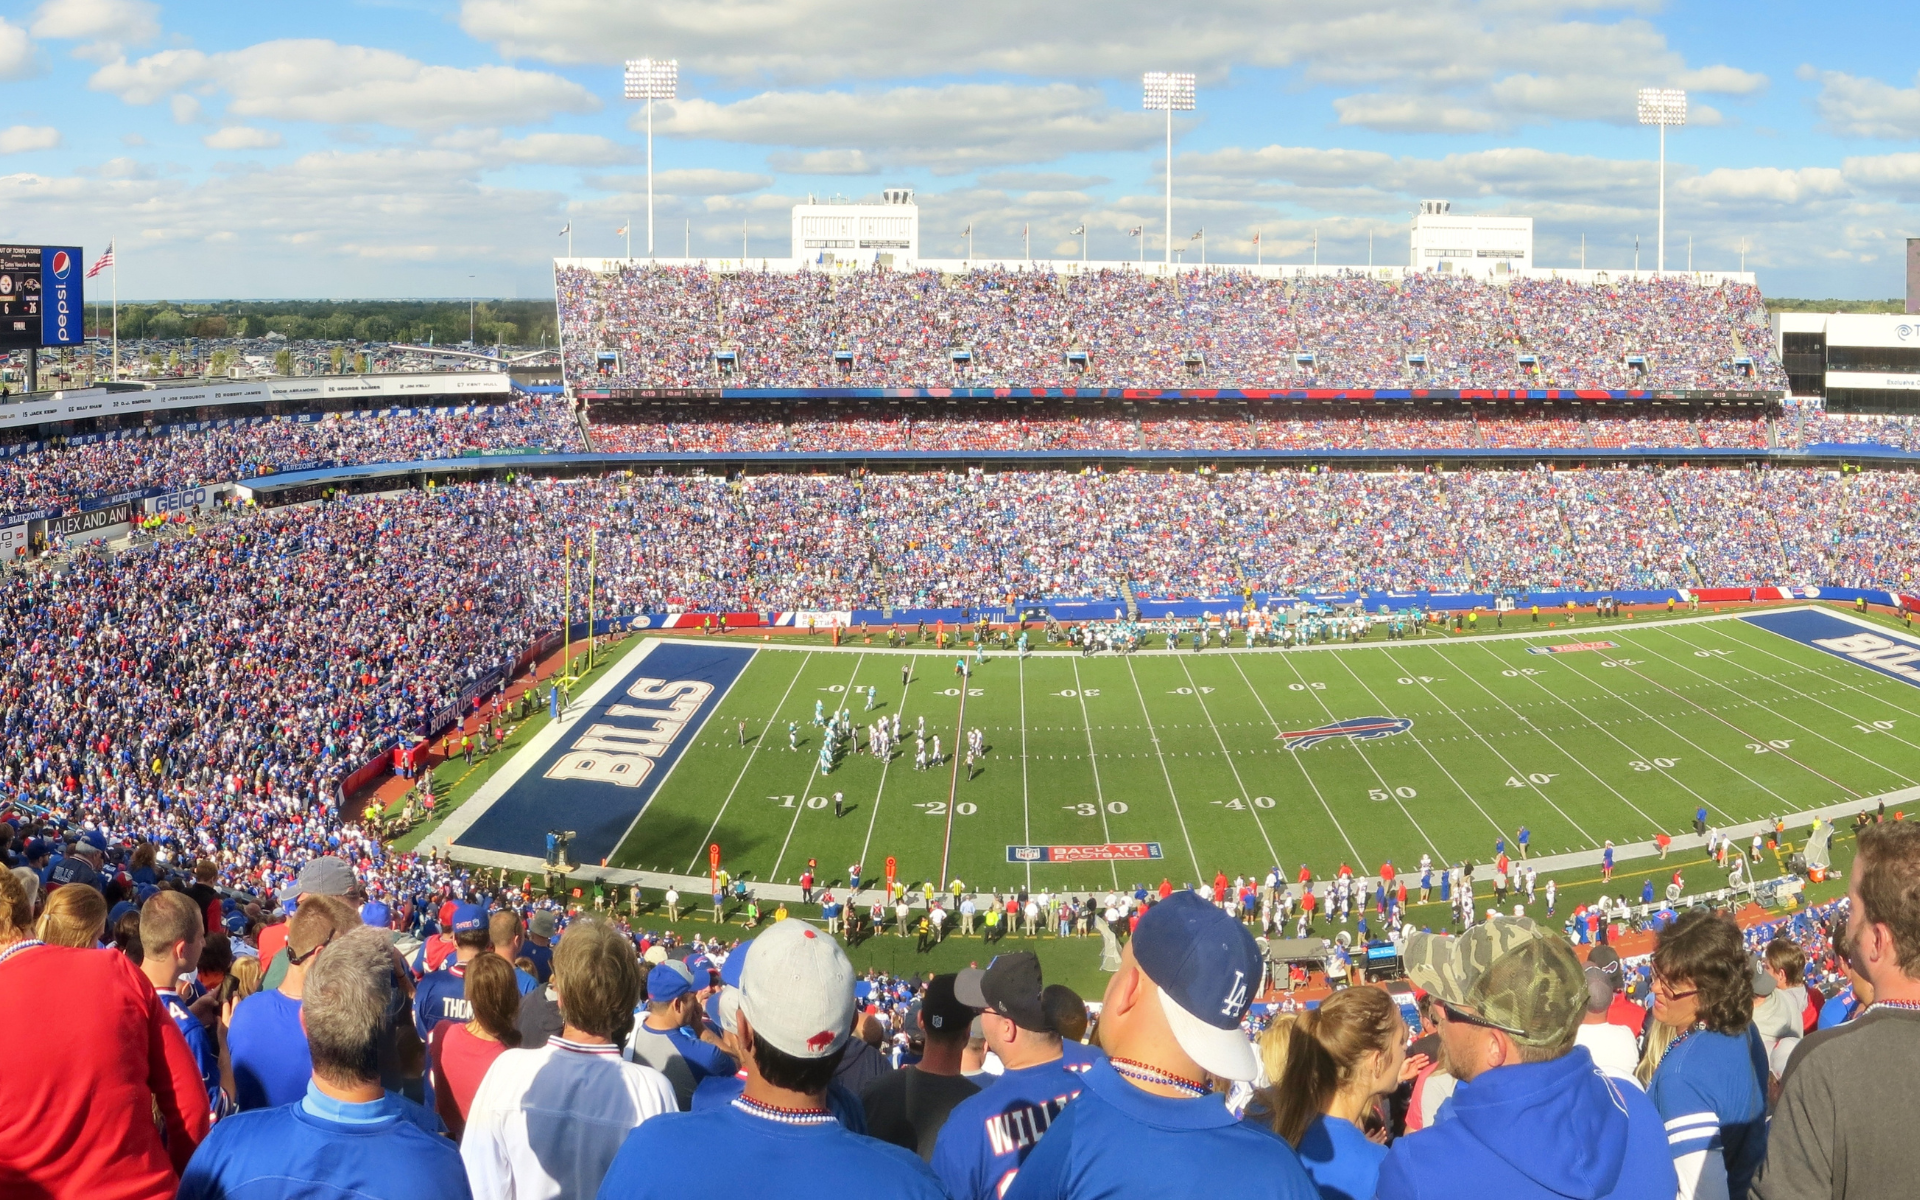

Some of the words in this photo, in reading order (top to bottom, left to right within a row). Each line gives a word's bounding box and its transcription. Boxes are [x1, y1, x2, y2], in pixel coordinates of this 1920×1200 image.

[16, 282, 23, 291] VS
[29, 302, 36, 314] 26
[56, 284, 69, 341] pepsi
[72, 437, 82, 446] 200
[112, 490, 142, 503] BLUEZONE
[156, 488, 206, 514] GEICO
[8, 510, 45, 524] BLUEZONE
[54, 517, 80, 535] ALEX
[83, 512, 107, 530] AND
[109, 506, 127, 524] ANI
[1397, 675, 1434, 685] 40
[944, 688, 985, 697] 20
[1060, 688, 1100, 697] 30
[1176, 686, 1215, 695] 40
[542, 678, 715, 788] BILLS
[1852, 720, 1894, 735] 10
[1745, 740, 1790, 754] 20
[1629, 758, 1675, 771] 30
[1505, 773, 1550, 788] 40
[1368, 786, 1417, 801] 50
[778, 795, 828, 809] 10
[925, 801, 977, 815] 20
[1077, 802, 1128, 816] 30
[1225, 797, 1276, 810] 40
[1054, 846, 1110, 854] BACK
[1222, 970, 1247, 1017] LA
[170, 1001, 188, 1020] 4
